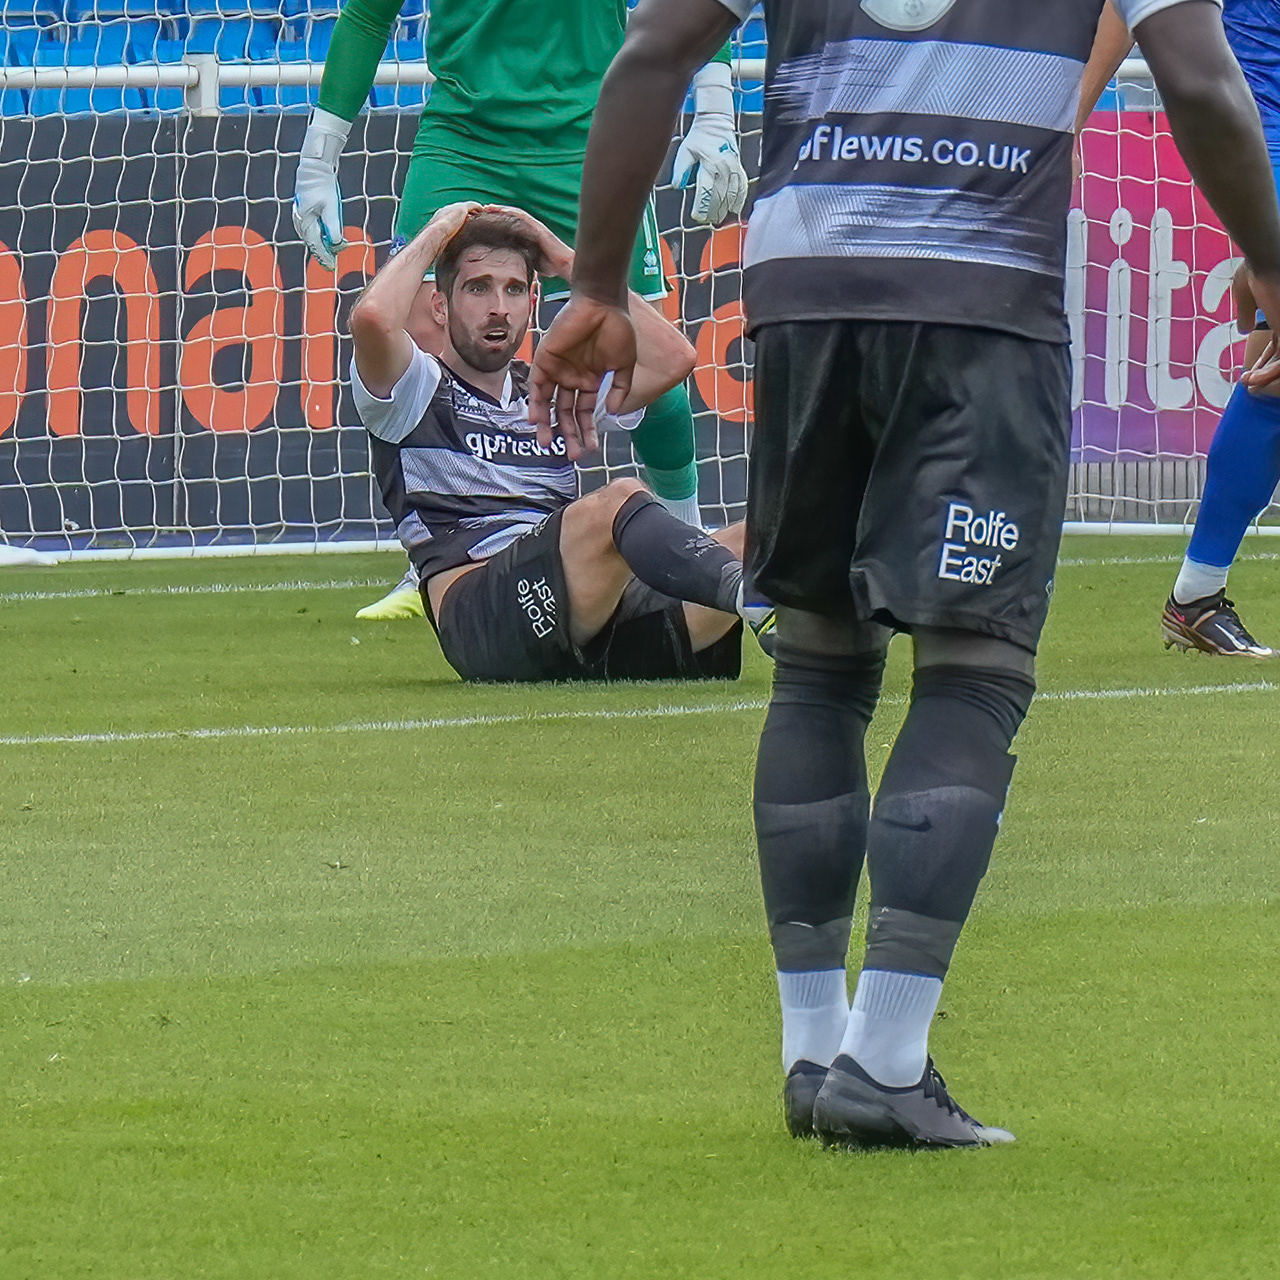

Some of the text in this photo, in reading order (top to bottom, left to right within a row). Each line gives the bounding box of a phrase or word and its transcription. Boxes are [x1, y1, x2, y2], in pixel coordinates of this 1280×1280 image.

[945, 503, 1019, 550] Rolfe
[938, 543, 1002, 585] East
[518, 578, 553, 638] Rolfe
